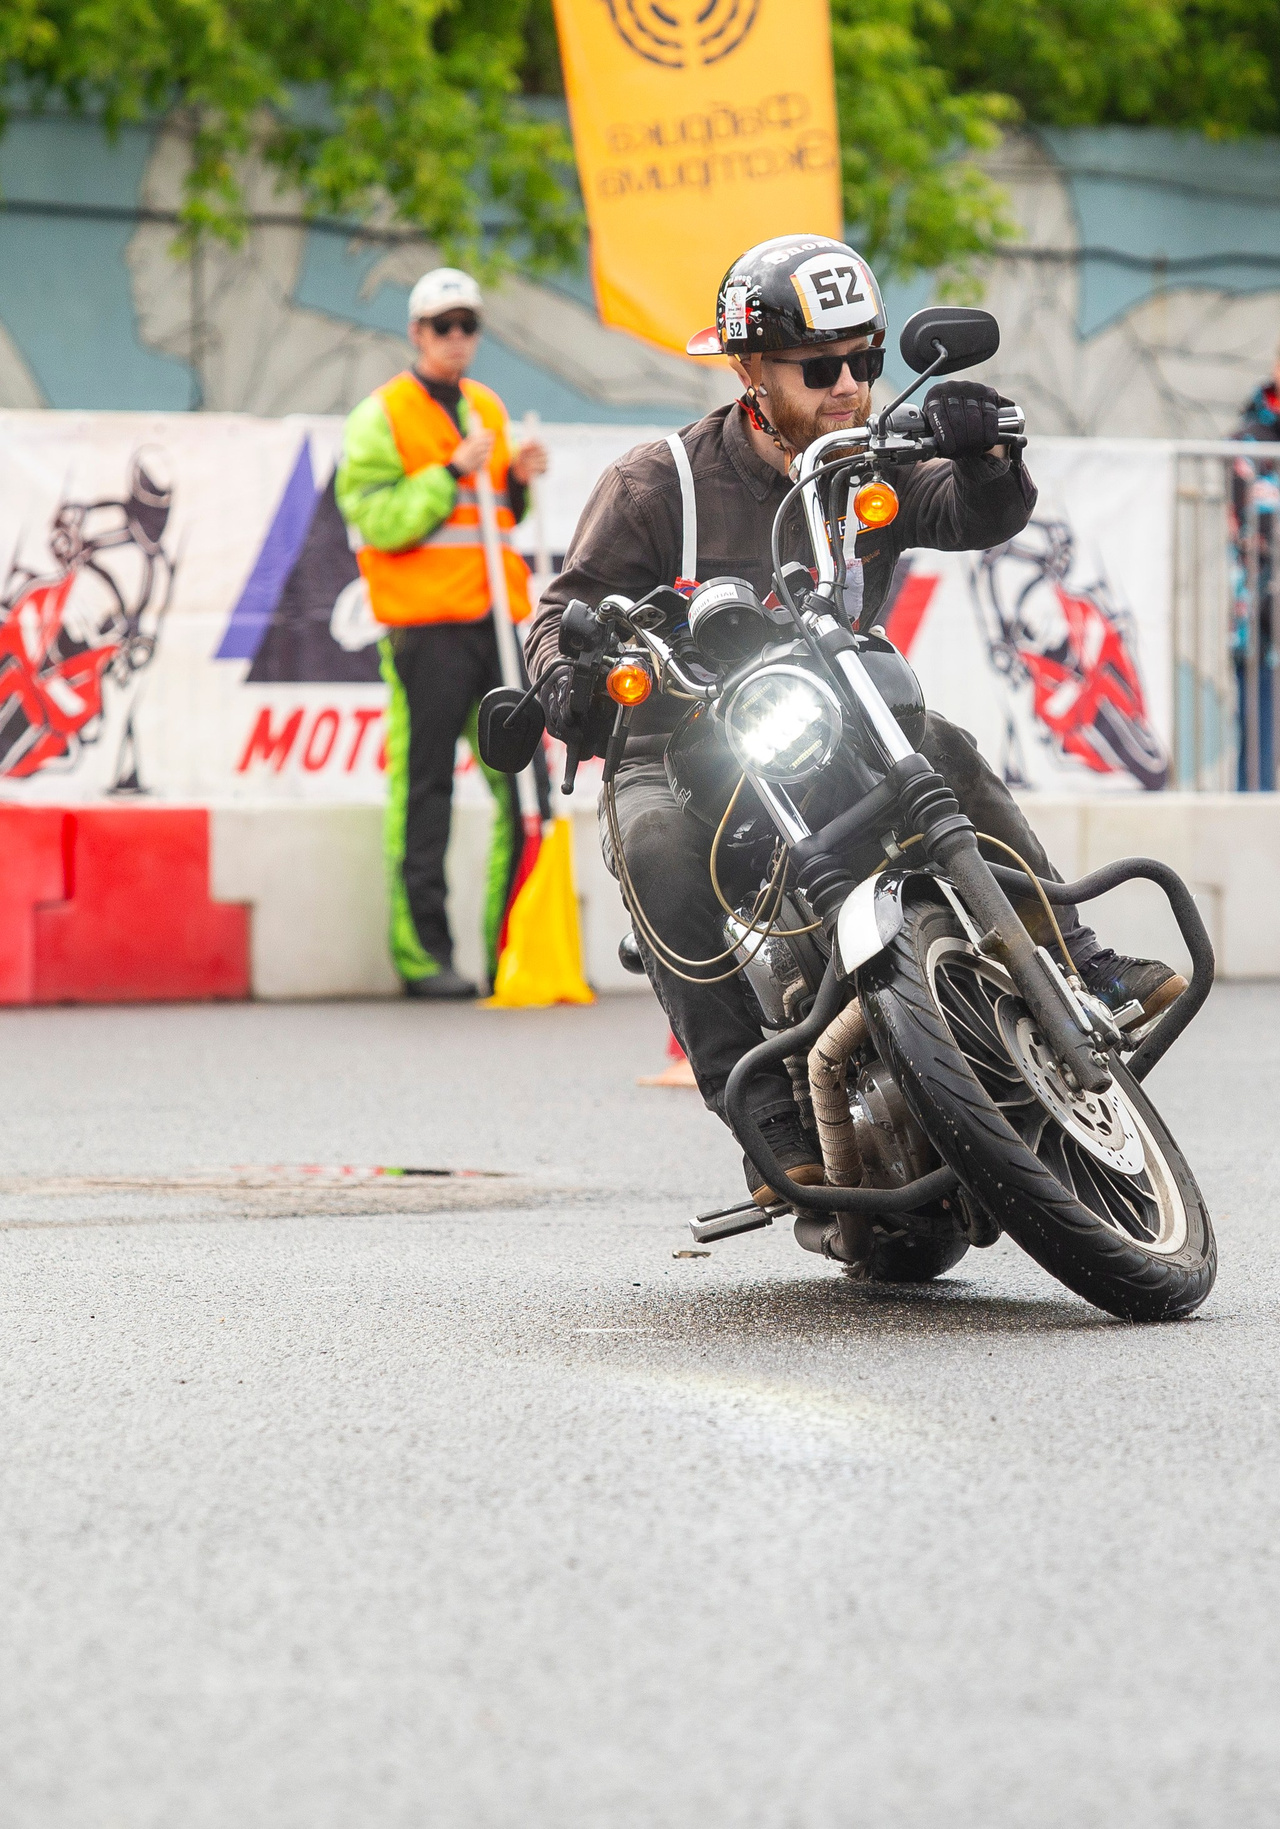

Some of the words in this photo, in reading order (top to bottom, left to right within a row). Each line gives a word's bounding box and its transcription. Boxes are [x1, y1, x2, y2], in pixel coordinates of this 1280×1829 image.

[810, 266, 865, 311] 52
[729, 321, 743, 338] 52
[236, 706, 390, 774] MOT
